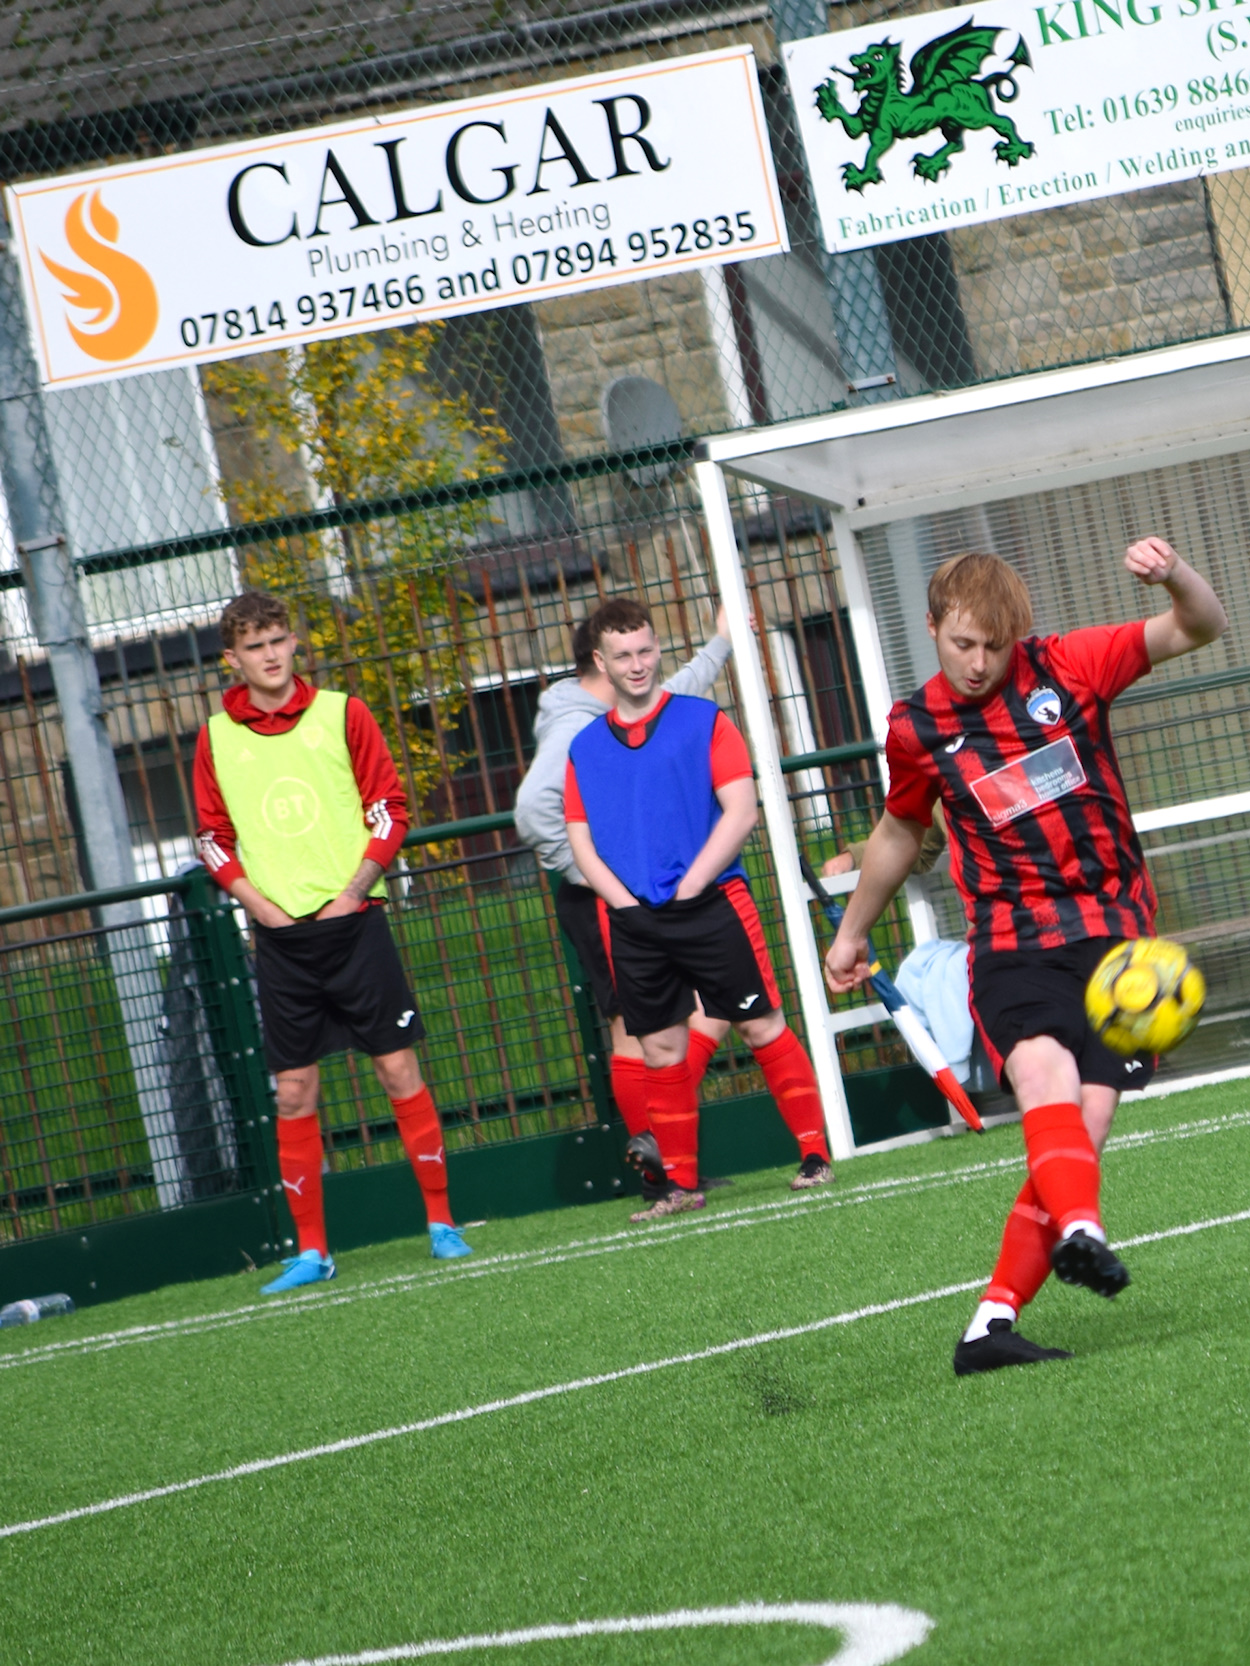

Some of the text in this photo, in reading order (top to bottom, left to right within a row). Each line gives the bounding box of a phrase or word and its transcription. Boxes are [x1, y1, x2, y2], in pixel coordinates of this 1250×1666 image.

[1043, 104, 1095, 135] Tel:
[1103, 84, 1179, 124] 01639
[225, 93, 672, 248] CALGAR
[838, 198, 977, 239] Fabrication
[998, 171, 1098, 206] Erection
[1117, 147, 1219, 179] Welding
[179, 210, 757, 349] 07814 937466 and 07894 952835
[308, 203, 611, 278] Plumbing & Heating
[273, 794, 306, 820] BT
